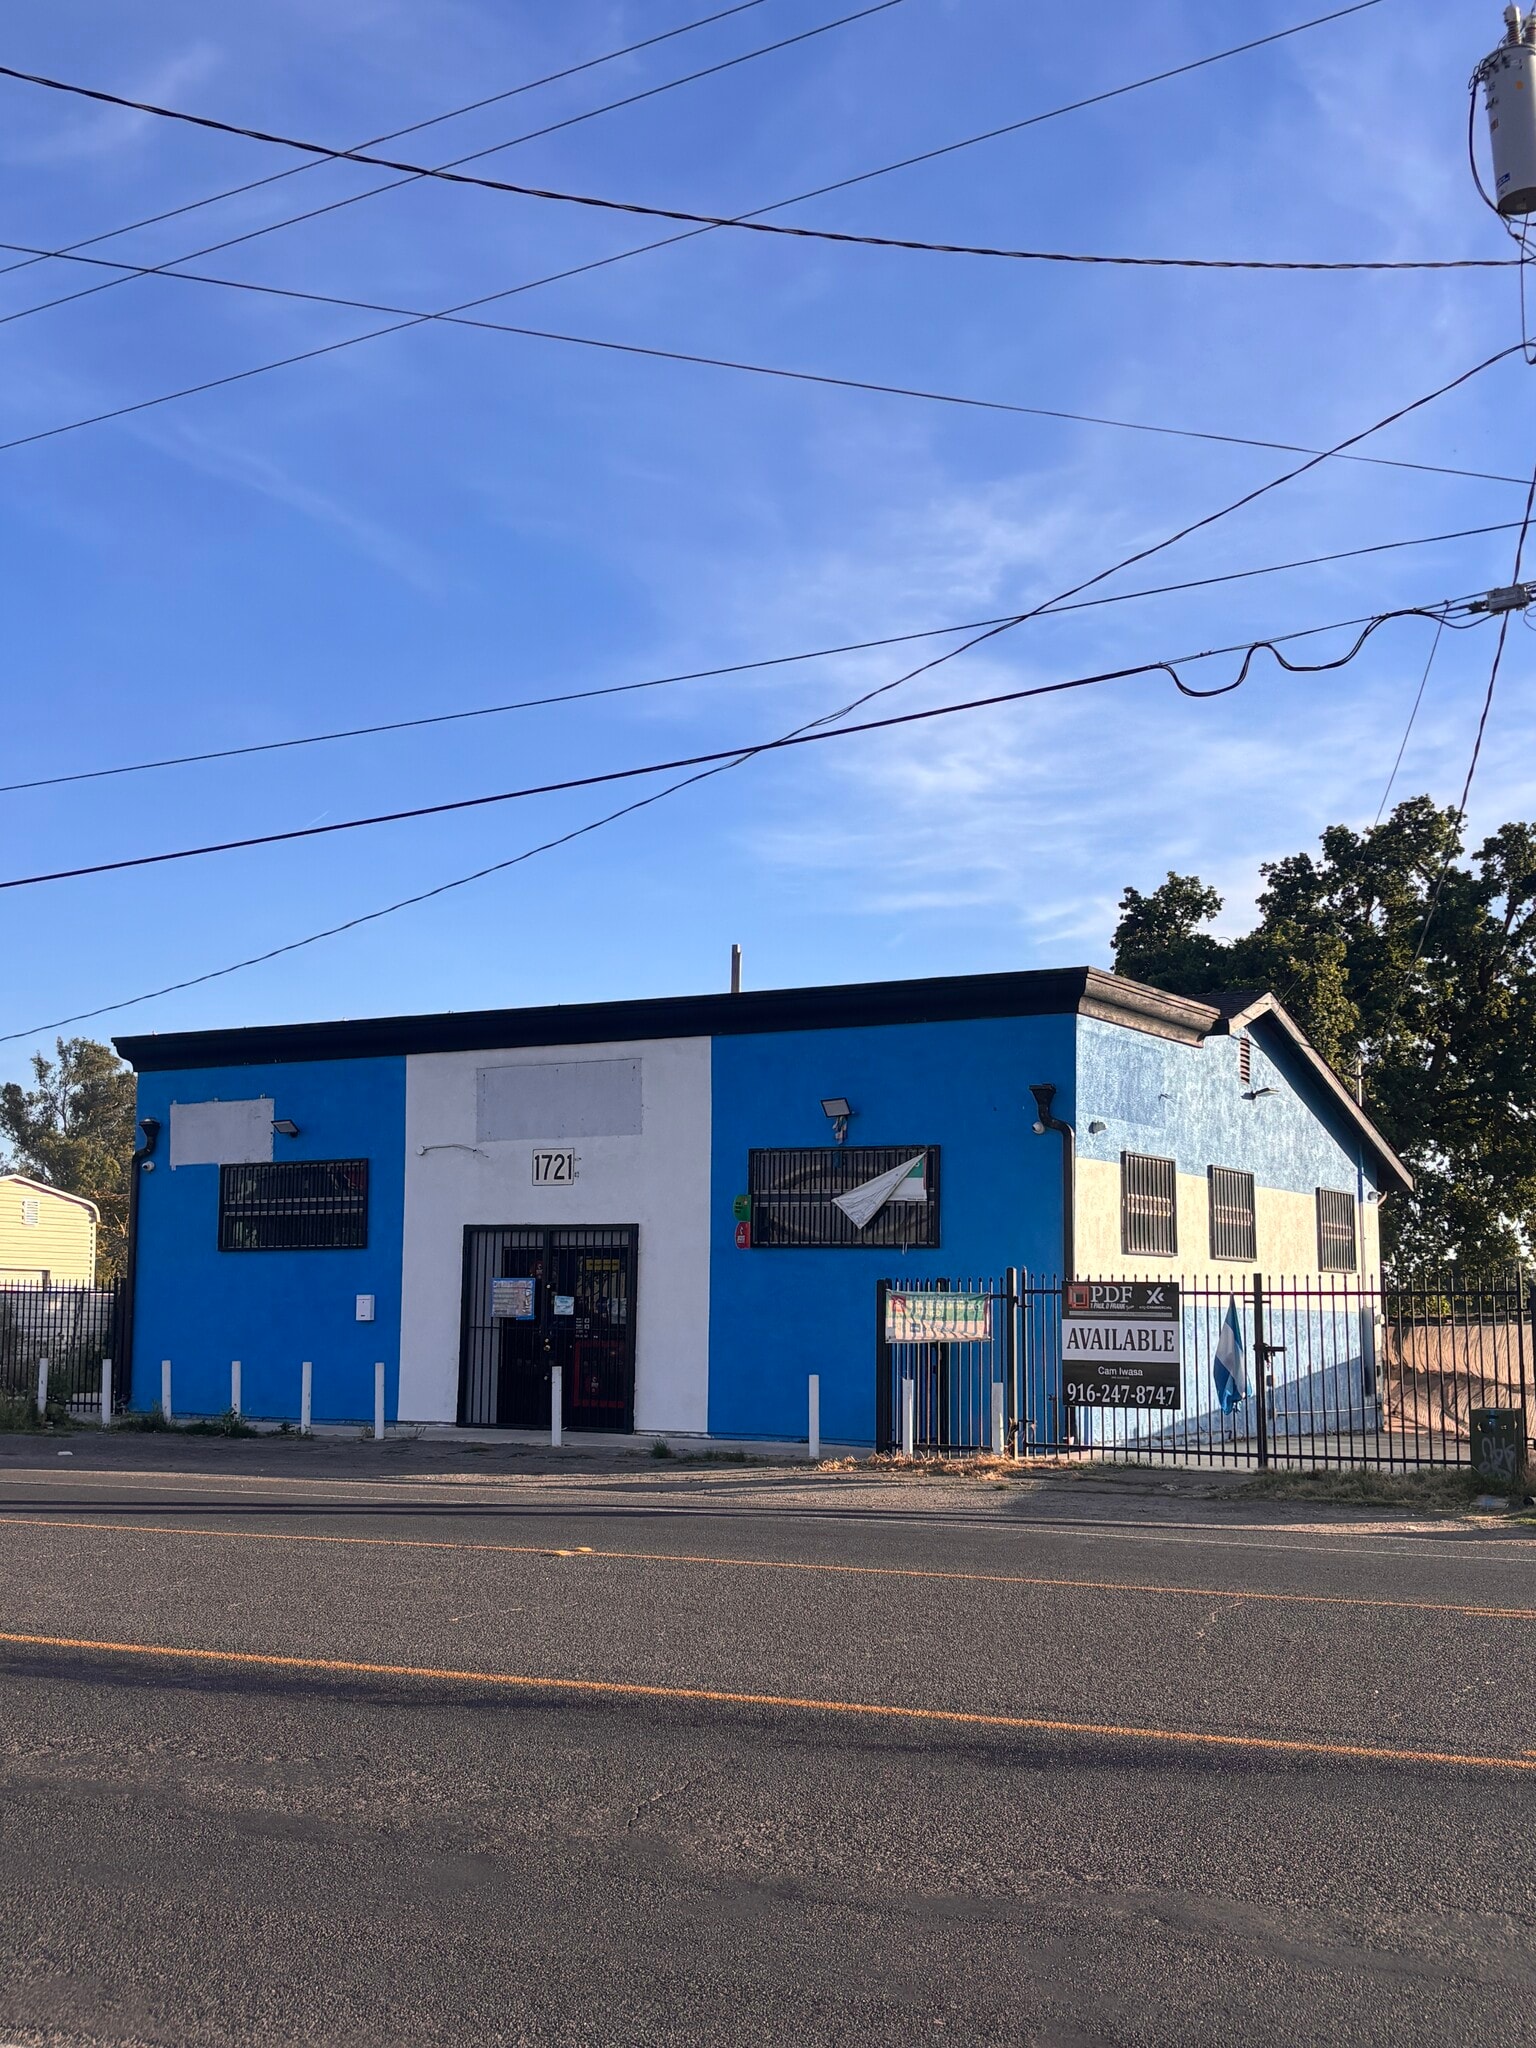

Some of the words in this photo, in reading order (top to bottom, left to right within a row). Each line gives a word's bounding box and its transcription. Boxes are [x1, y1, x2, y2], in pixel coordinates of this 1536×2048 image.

[535, 1154, 572, 1180] 1721
[1090, 1285, 1133, 1303] PDF
[1066, 1327, 1175, 1352] AVAILABLE
[1098, 1366, 1117, 1376] Cam
[1119, 1367, 1143, 1376] Iwasa
[1067, 1383, 1175, 1405] 916-247-8747
